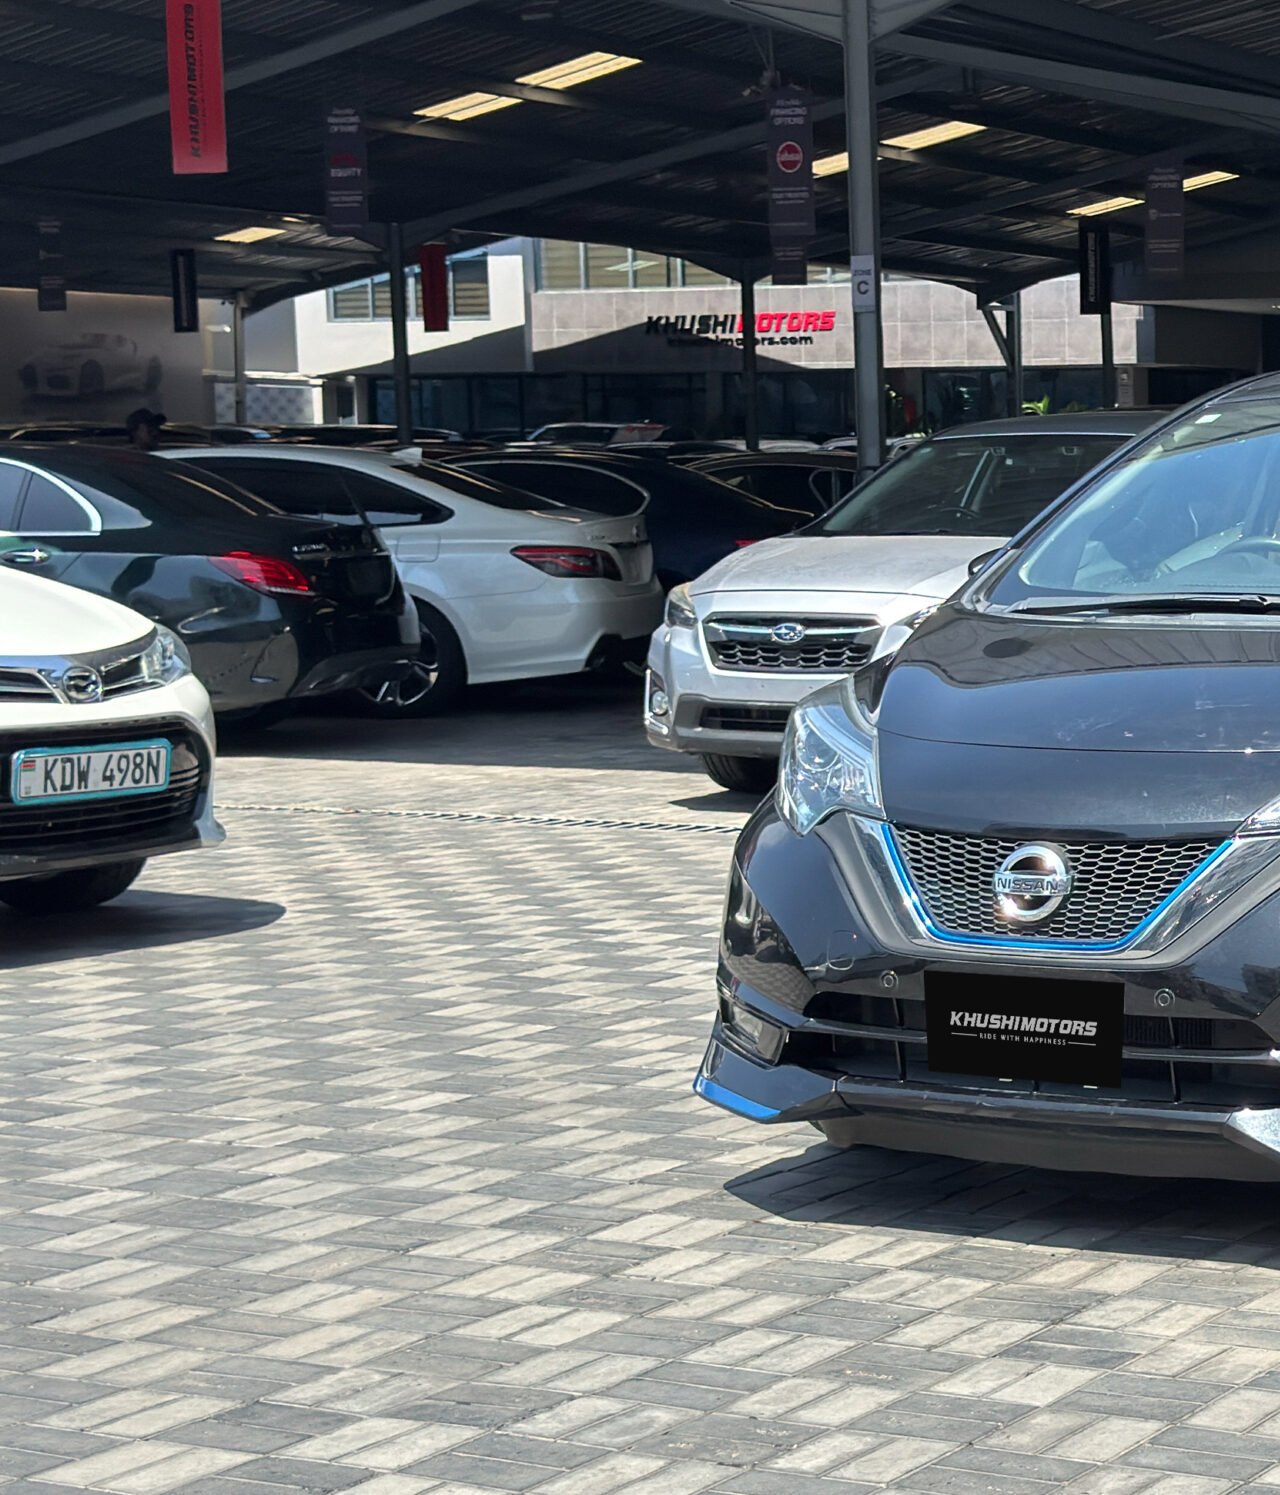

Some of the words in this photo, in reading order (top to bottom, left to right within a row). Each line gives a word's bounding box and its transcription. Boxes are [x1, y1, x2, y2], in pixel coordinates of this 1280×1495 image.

[857, 280, 869, 295] C
[43, 755, 92, 793] KDW
[101, 750, 160, 787] 498N
[997, 877, 1058, 892] NISSAN
